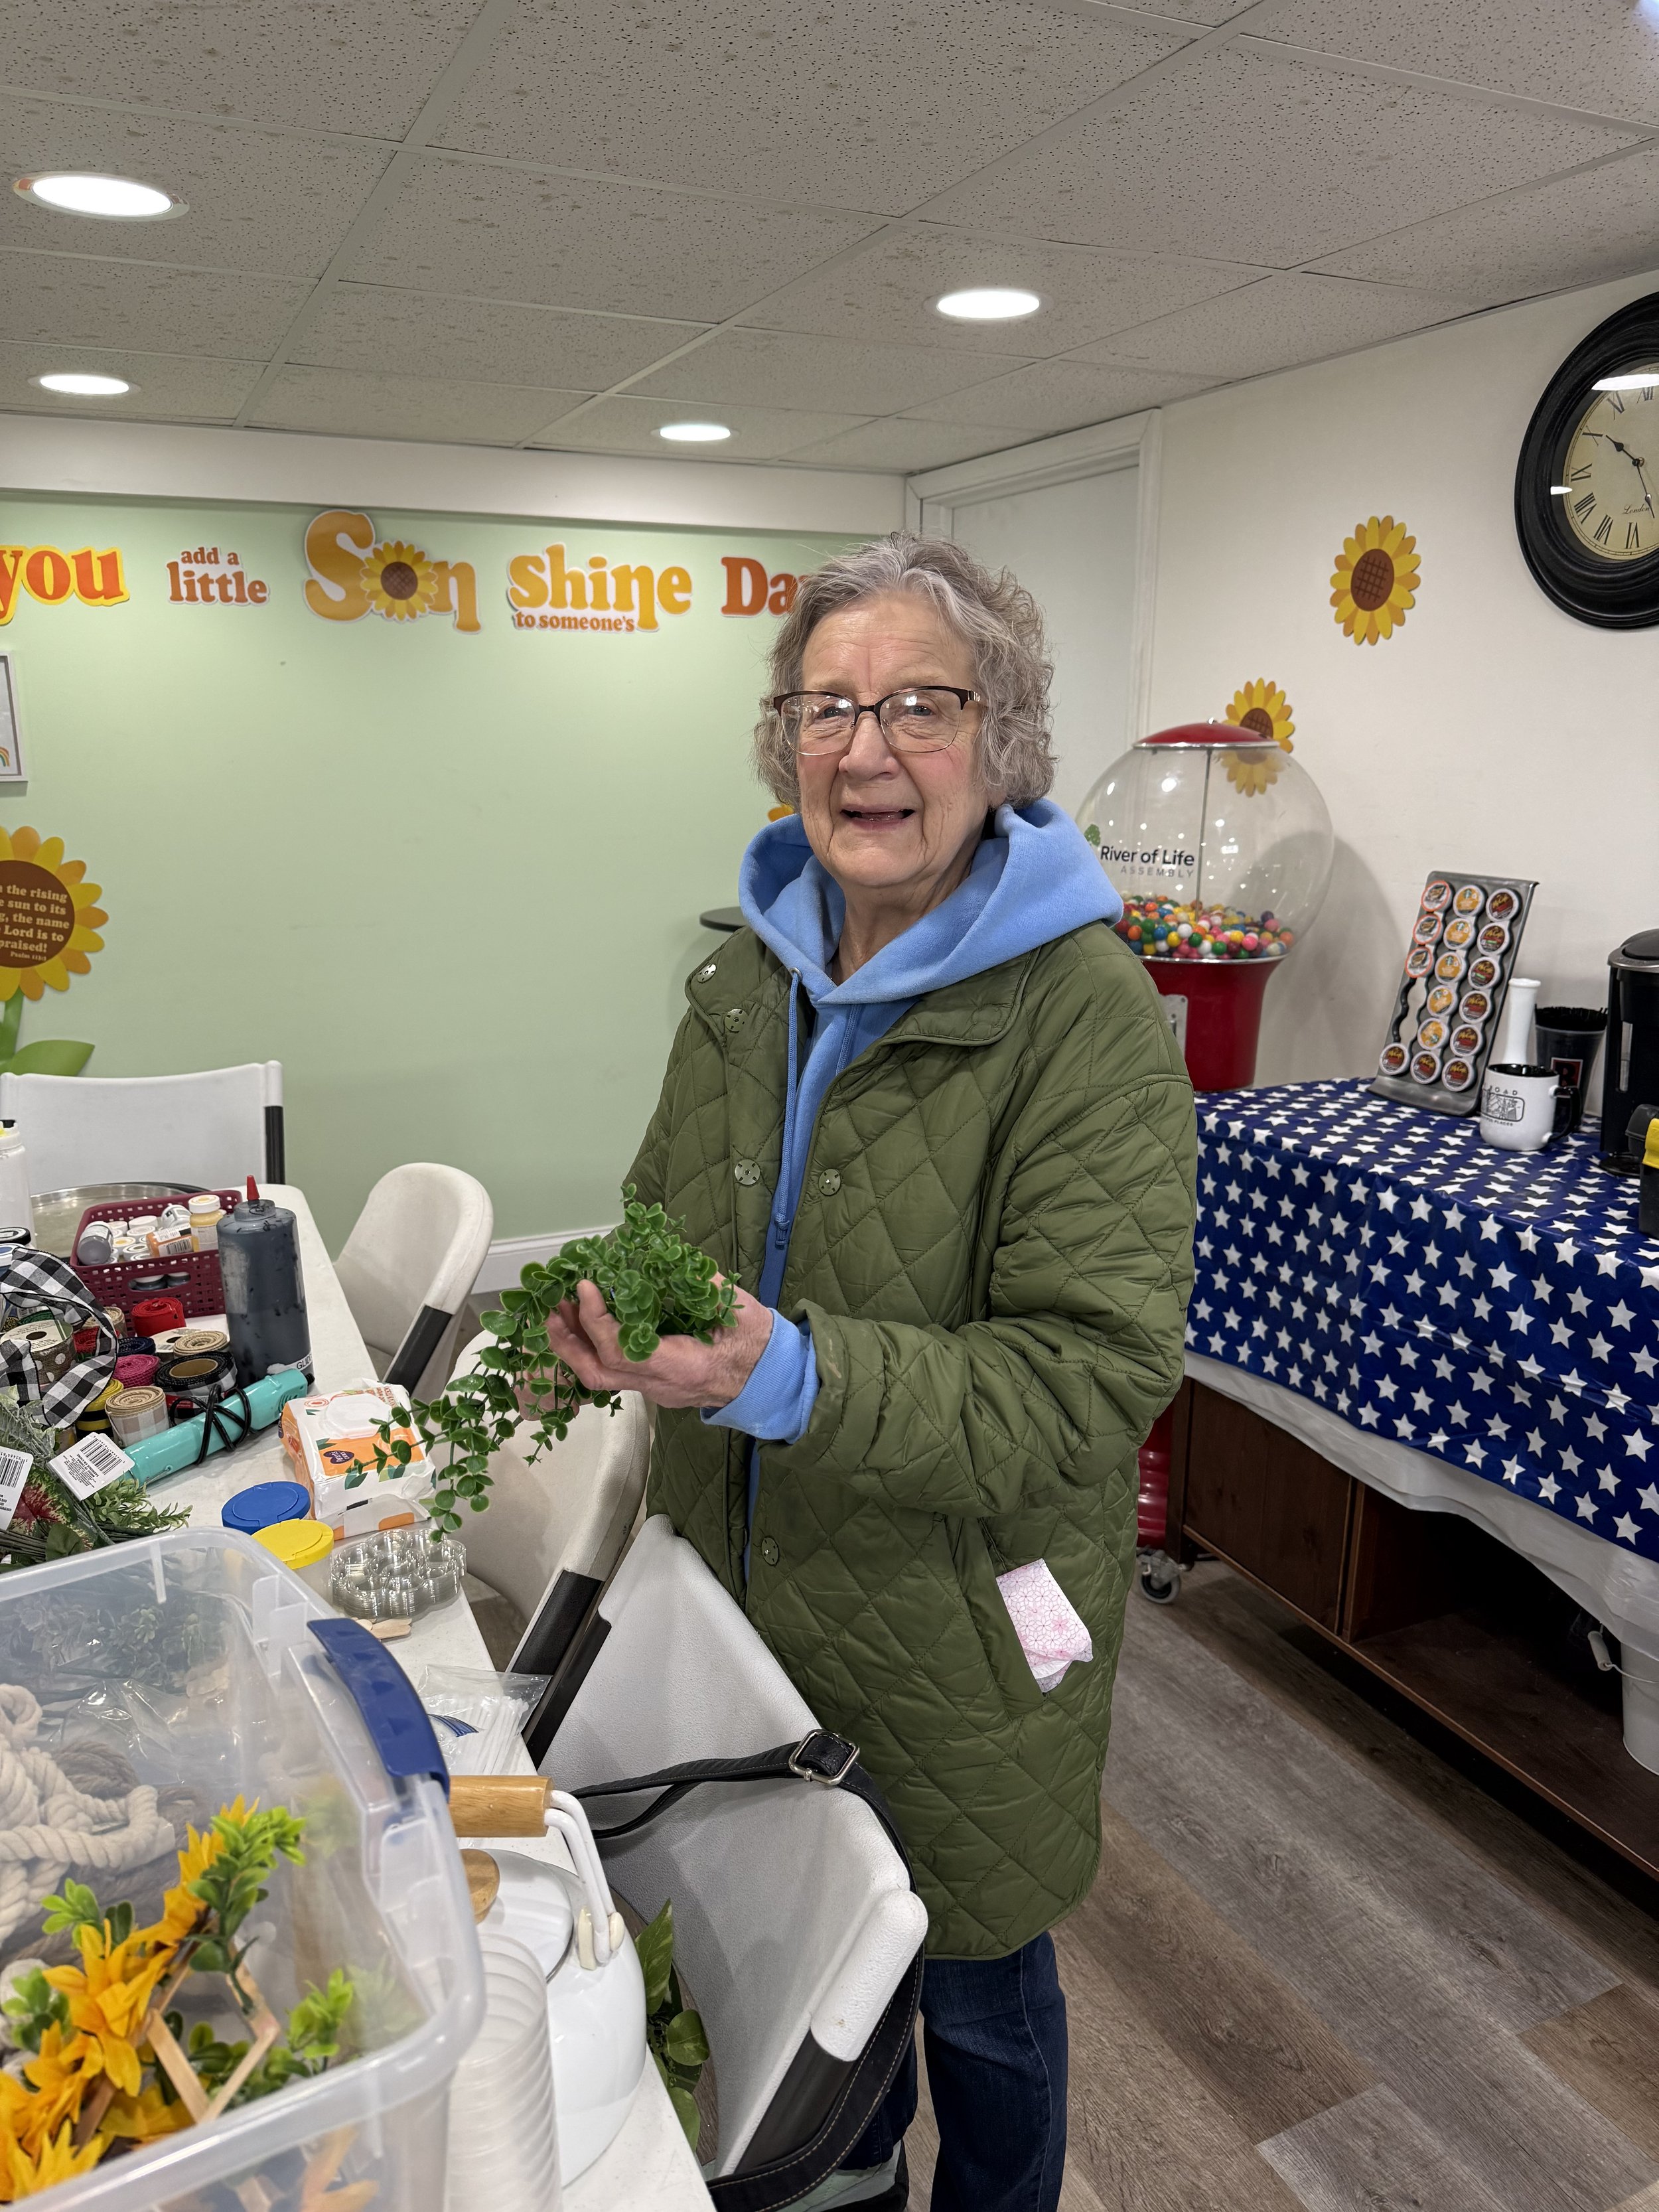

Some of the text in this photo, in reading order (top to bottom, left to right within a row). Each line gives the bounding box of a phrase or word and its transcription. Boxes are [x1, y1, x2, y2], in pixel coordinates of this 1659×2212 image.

[180, 546, 240, 565] add a
[0, 549, 125, 620] you
[166, 561, 267, 603] little
[721, 556, 809, 617] Da
[516, 610, 634, 631] to someone's
[1100, 846, 1194, 867] River of Life
[1121, 865, 1194, 878] ASSEMBLY
[7, 884, 27, 896] the
[30, 888, 68, 904] rising
[7, 900, 31, 911] sun
[34, 903, 46, 913] to
[50, 903, 66, 915] its
[13, 913, 33, 924] the
[36, 917, 70, 929] name
[3, 924, 64, 942] Lord is to
[10, 950, 30, 959] Psalm
